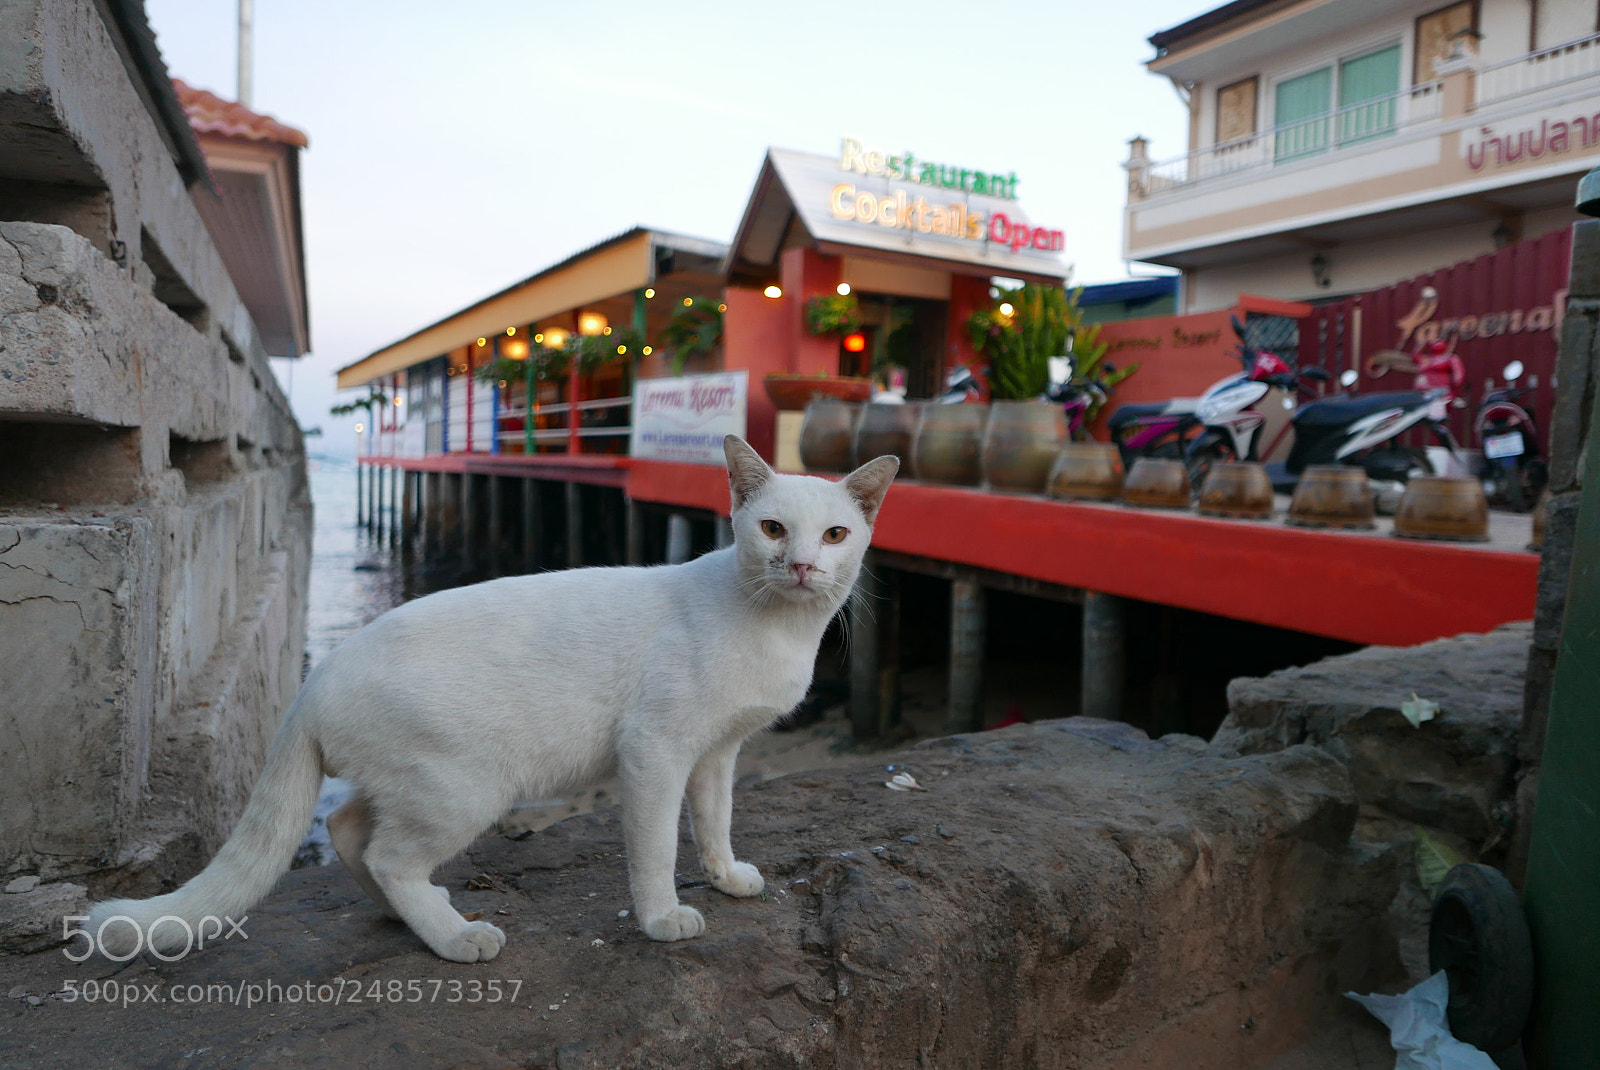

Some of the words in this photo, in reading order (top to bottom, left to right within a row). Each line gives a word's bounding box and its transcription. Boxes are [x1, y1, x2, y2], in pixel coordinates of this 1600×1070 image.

[841, 135, 1019, 200] Restaurant
[829, 183, 983, 240] Cocktails
[988, 212, 1065, 253] Open
